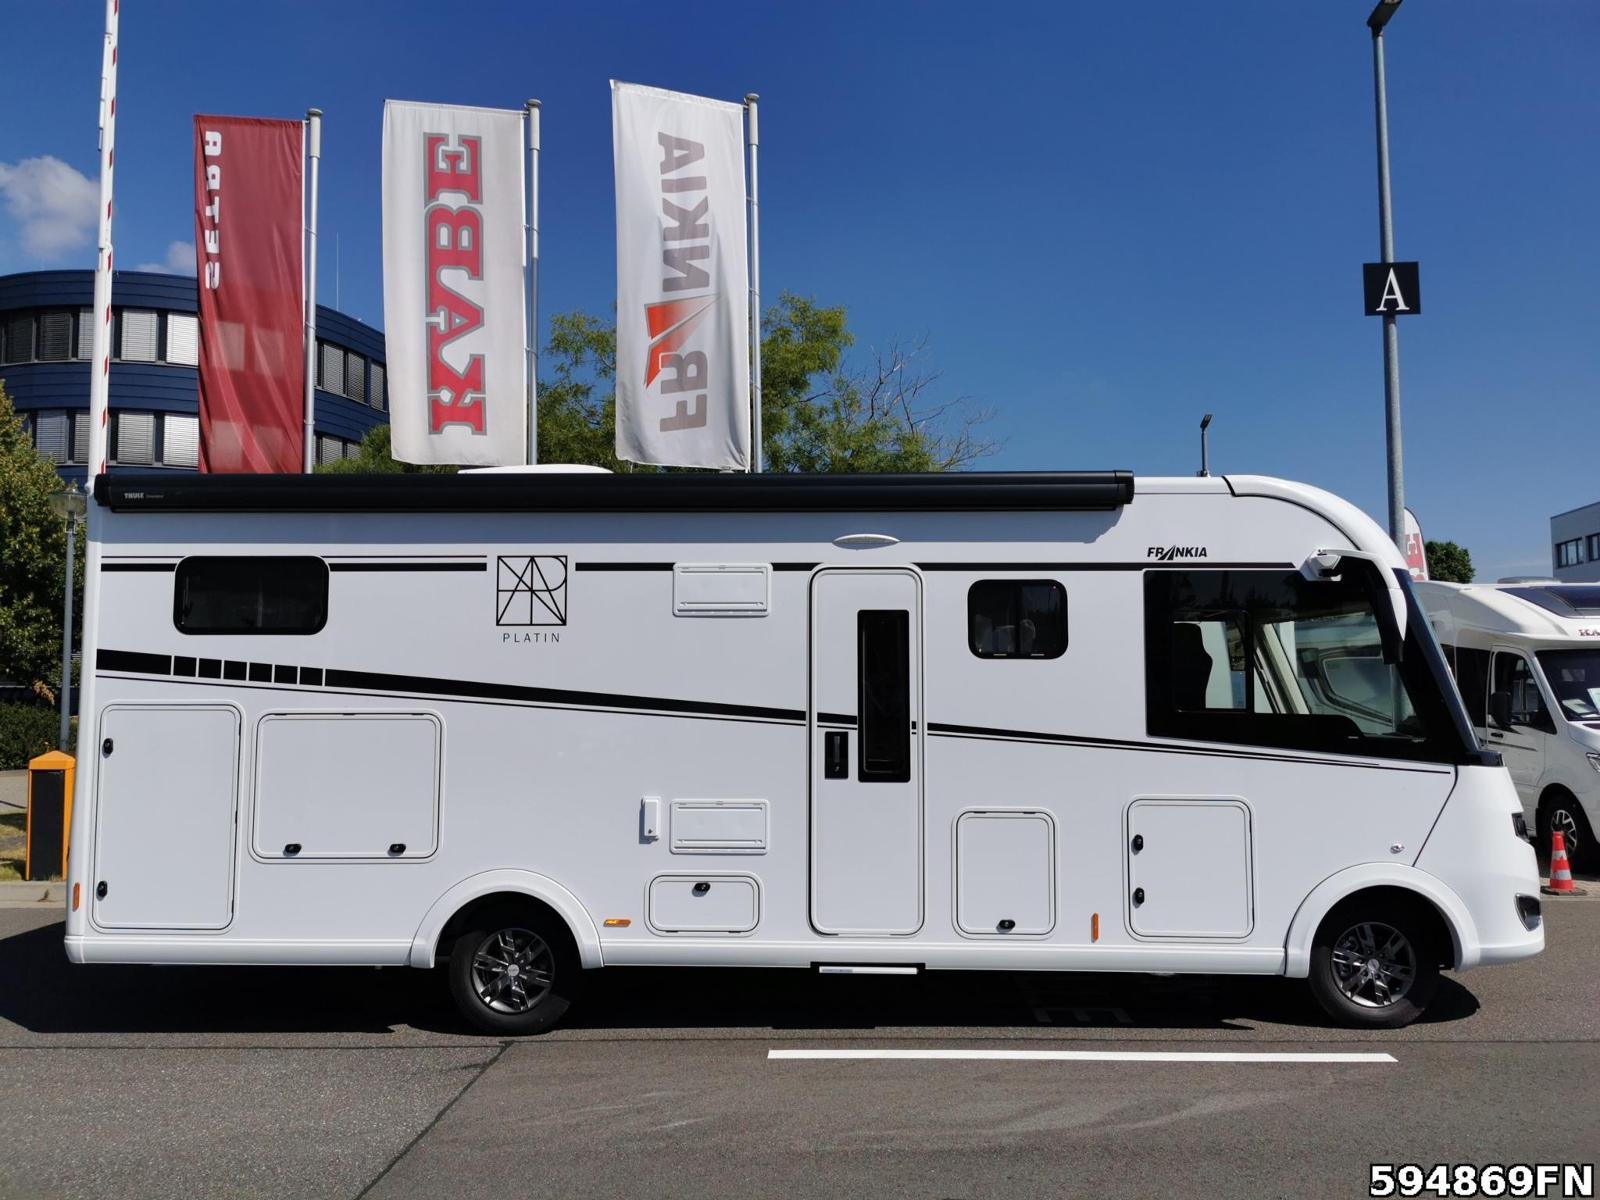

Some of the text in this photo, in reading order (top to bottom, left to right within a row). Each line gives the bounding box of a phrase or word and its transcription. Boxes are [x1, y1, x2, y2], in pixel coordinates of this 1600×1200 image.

[1376, 266, 1410, 312] A
[1147, 544, 1207, 560] FRANKIA
[503, 632, 560, 643] PLATIN
